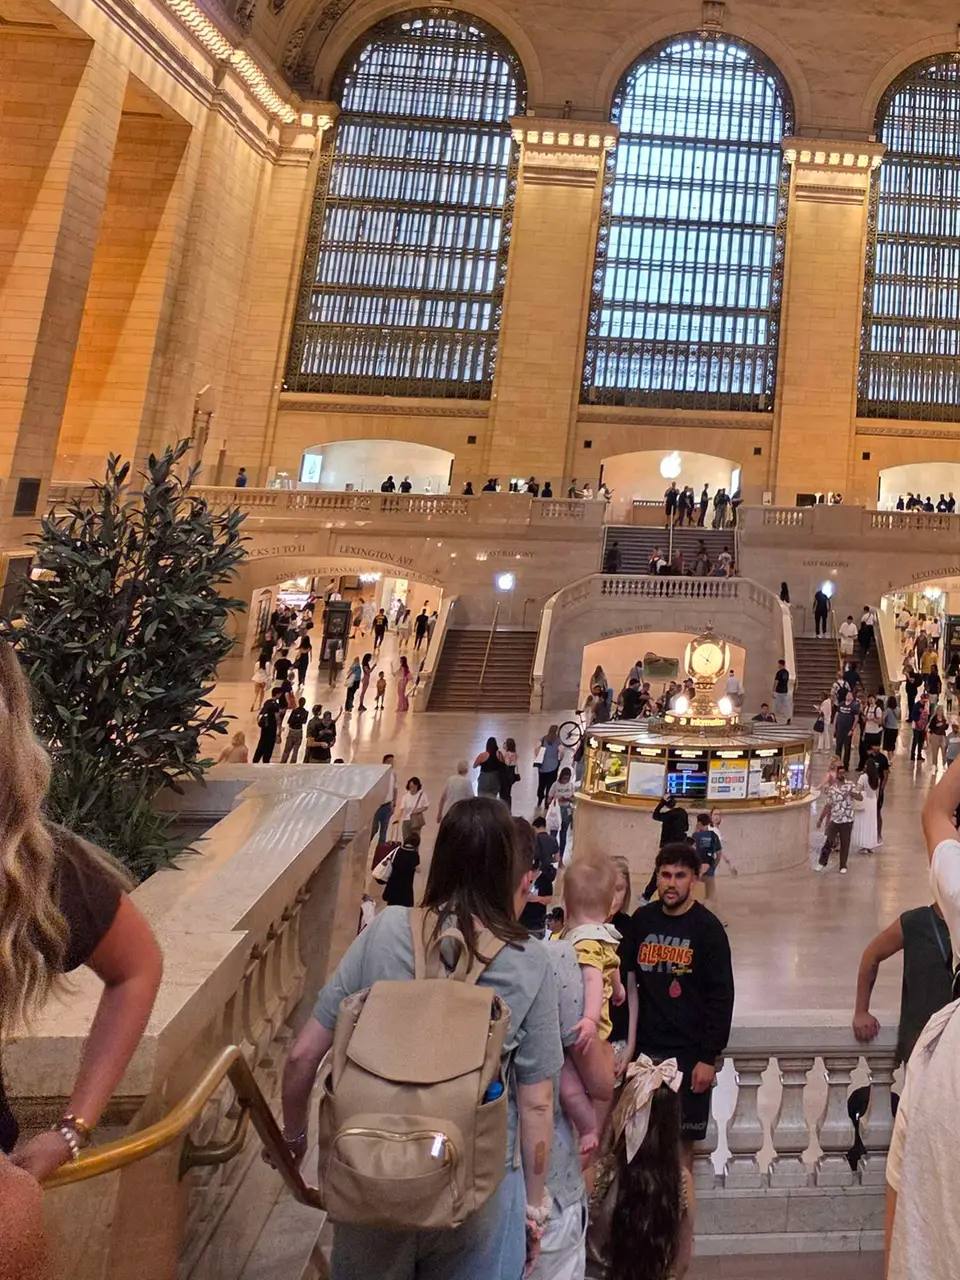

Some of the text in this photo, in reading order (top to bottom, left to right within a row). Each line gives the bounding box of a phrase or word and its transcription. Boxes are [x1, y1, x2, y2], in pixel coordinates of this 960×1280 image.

[284, 545, 296, 554] TO
[340, 545, 396, 561] LEXINGTON
[911, 566, 960, 580] LEXINGTON
